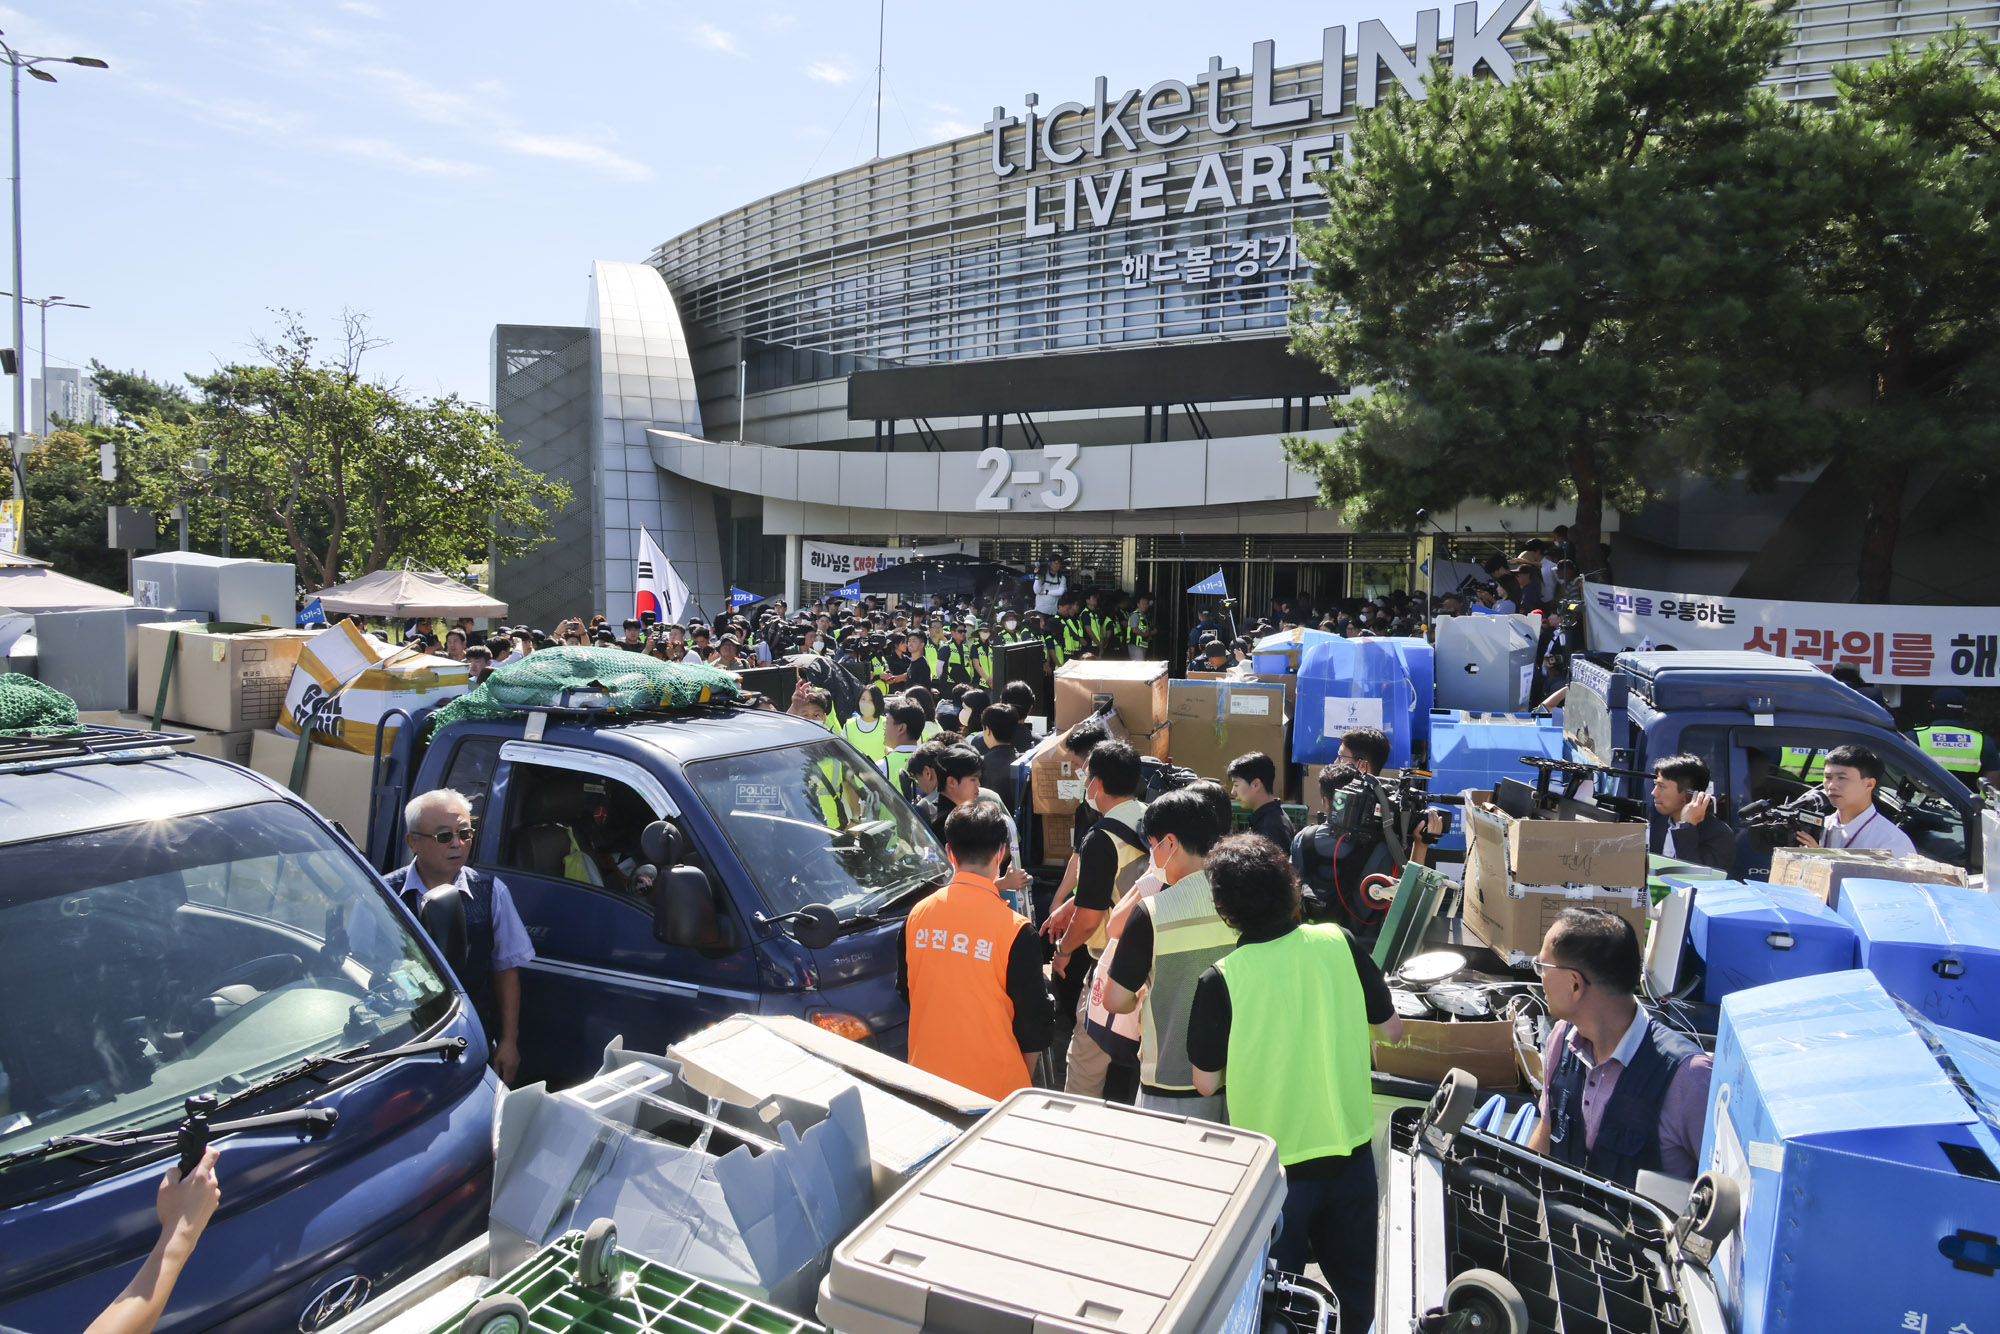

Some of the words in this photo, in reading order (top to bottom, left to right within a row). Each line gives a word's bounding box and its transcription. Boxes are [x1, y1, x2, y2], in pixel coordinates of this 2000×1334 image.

[1025, 162, 1168, 238] LIVE
[1183, 132, 1351, 214] ARE
[1121, 246, 1214, 290] 핸드볼
[1230, 234, 1310, 278] 경기
[975, 443, 1080, 511] 2-3
[810, 551, 850, 573] 하나님은
[1597, 591, 1653, 616] 국민을
[1658, 599, 1736, 625] 우롱하는
[1791, 747, 1828, 755] POLCE
[739, 786, 777, 796] POLICE
[915, 928, 994, 962] 안전요원
